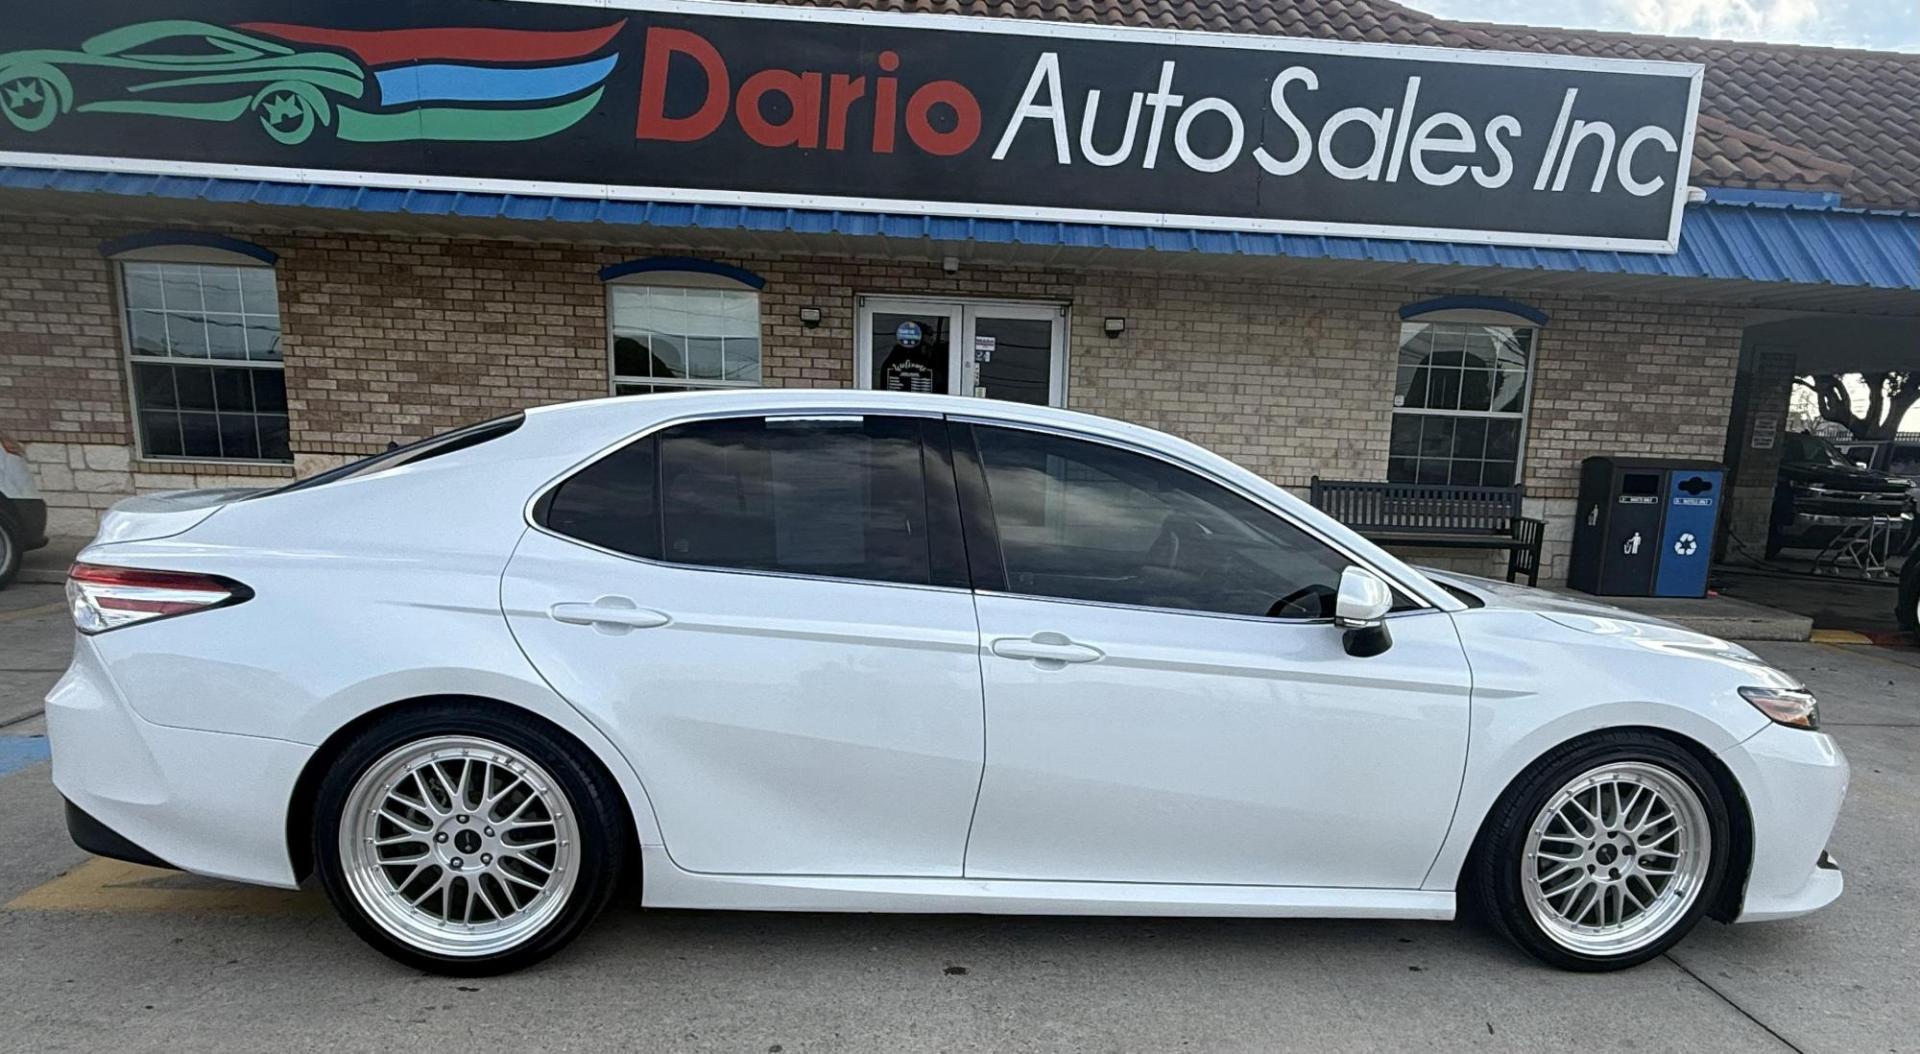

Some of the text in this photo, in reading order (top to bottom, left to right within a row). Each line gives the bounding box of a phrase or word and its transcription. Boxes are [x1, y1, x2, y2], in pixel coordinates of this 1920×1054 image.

[637, 28, 1679, 197] Dario Auto Sales Inc
